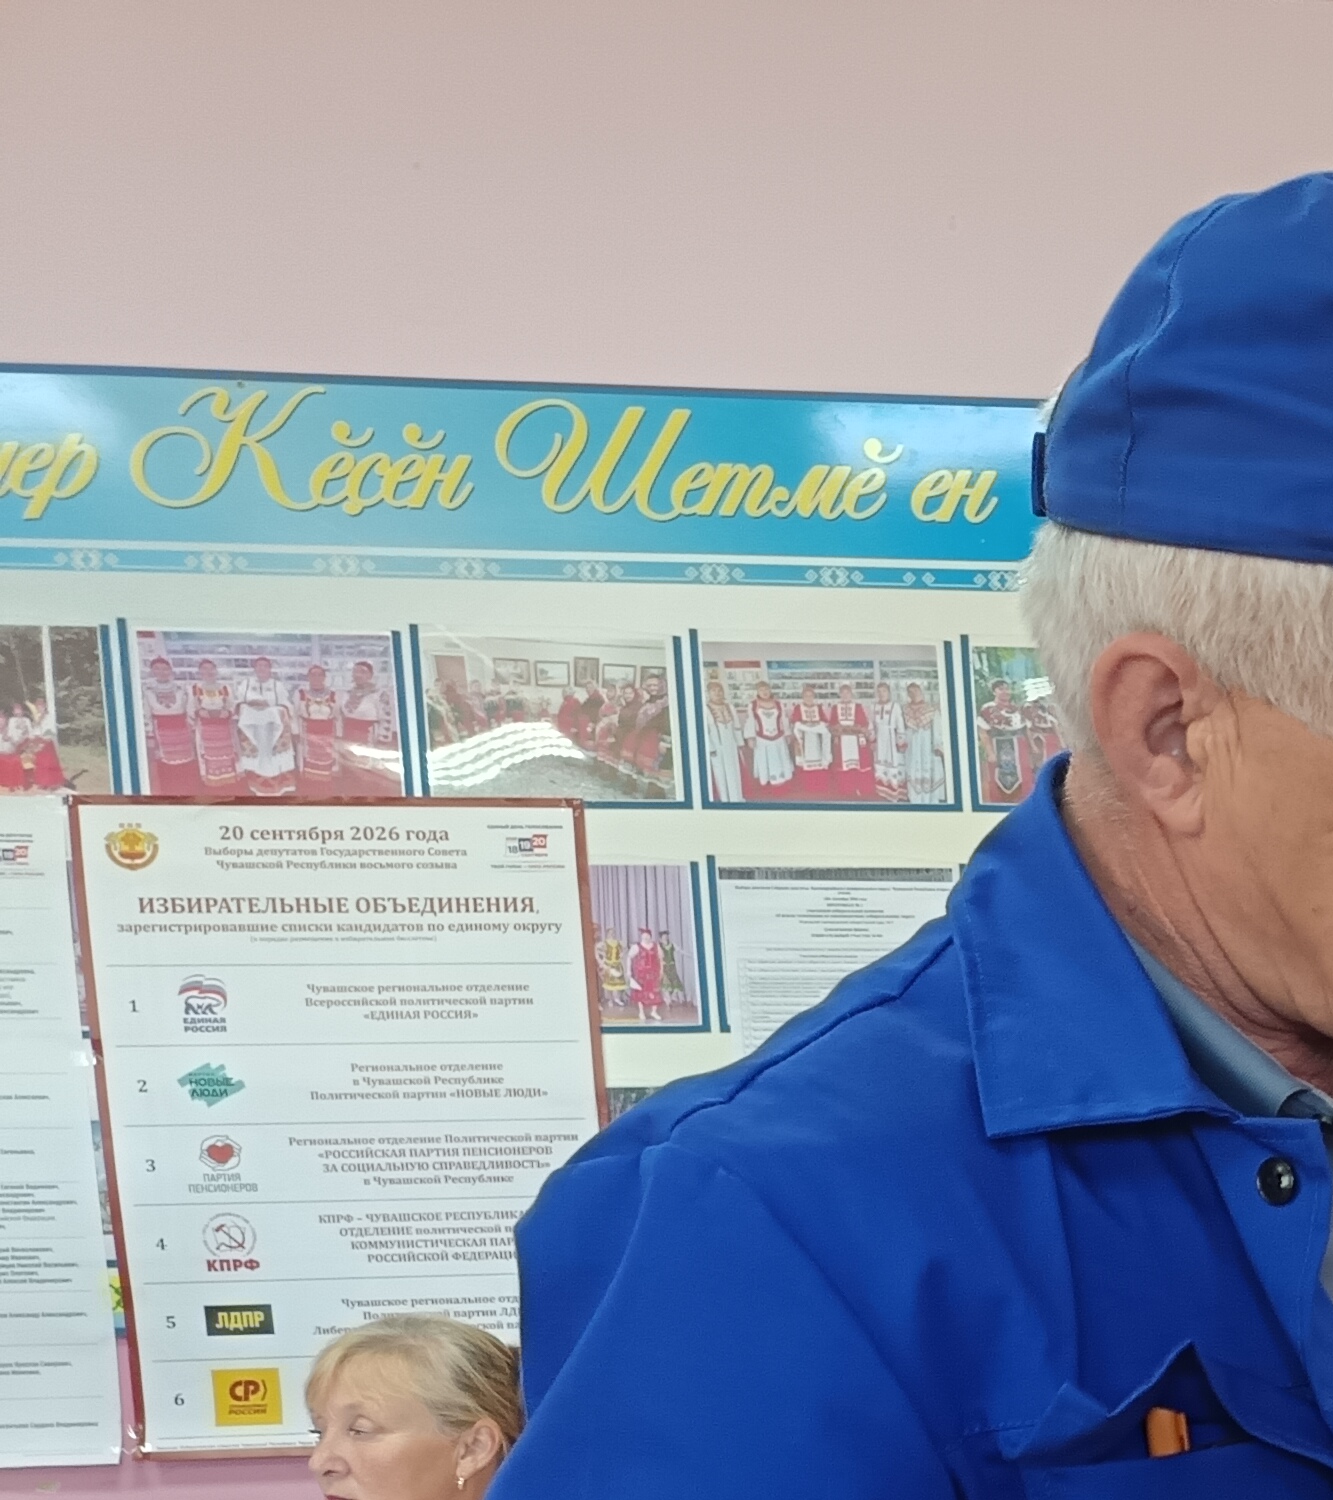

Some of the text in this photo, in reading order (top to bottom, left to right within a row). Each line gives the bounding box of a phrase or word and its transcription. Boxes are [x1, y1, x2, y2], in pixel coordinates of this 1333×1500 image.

[909, 467, 1002, 526] ен
[219, 825, 449, 844] 20 сентября 2026 года
[204, 847, 468, 859] Выборы депутатов Государственного Совета
[216, 860, 457, 872] Чувашской Республики восьмого созыва
[138, 896, 540, 917] ИЗБИРАТЕЛЬНЫЕ ОБЪЕДИНЕНИЯ,
[117, 921, 563, 936] зарегистрировавшие списки кандидатов по единому округу
[307, 983, 530, 995] Чувашское региональное отделение
[128, 999, 140, 1013] 1
[305, 996, 534, 1008] Всероссийской политической партии
[183, 1025, 227, 1033] РОССИЯ
[351, 1062, 504, 1074] Региональное отделение
[136, 1079, 148, 1093] 2
[189, 1077, 235, 1087] НОВЫЕ
[353, 1075, 504, 1087] в Чувашской Республике
[191, 1088, 229, 1097] ЛЮДИ
[310, 1090, 400, 1101] Политической
[403, 1089, 447, 1101] партии
[288, 1133, 579, 1147] Региональное отделение Политической партии
[409, 1147, 460, 1158] ПАРТИЯ
[462, 1146, 553, 1157] ПЕНСИОНЕРОВ
[145, 1158, 156, 1172] 3
[322, 1163, 338, 1173] ЗА
[341, 1161, 430, 1174] СОЦИАЛЬНУЮ
[203, 1173, 242, 1182] ПАРТИЯ
[373, 1175, 442, 1186] Чувашской
[444, 1174, 514, 1185] Республике
[188, 1183, 258, 1194] ПЕНСИОНЕРОВ
[318, 1213, 354, 1224] КПРФ
[366, 1212, 443, 1223] ЧУВАШСКОЕ
[339, 1226, 413, 1238] ОТДЕЛЕНИЕ
[415, 1225, 502, 1236] политической
[155, 1238, 168, 1251] 4
[351, 1237, 515, 1251] КОММУНИСТИЧЕСКАЯ ПАР
[367, 1251, 518, 1263] РОССИЙСКОЙ ФЕДЕРАЦИ
[206, 1258, 260, 1272] КПРФ
[341, 1298, 409, 1308] Чувашское
[411, 1297, 496, 1308] региональное
[453, 1308, 498, 1319] партии
[166, 1315, 177, 1329] 5
[215, 1310, 265, 1331] ЛДПР
[174, 1393, 185, 1407] 6
